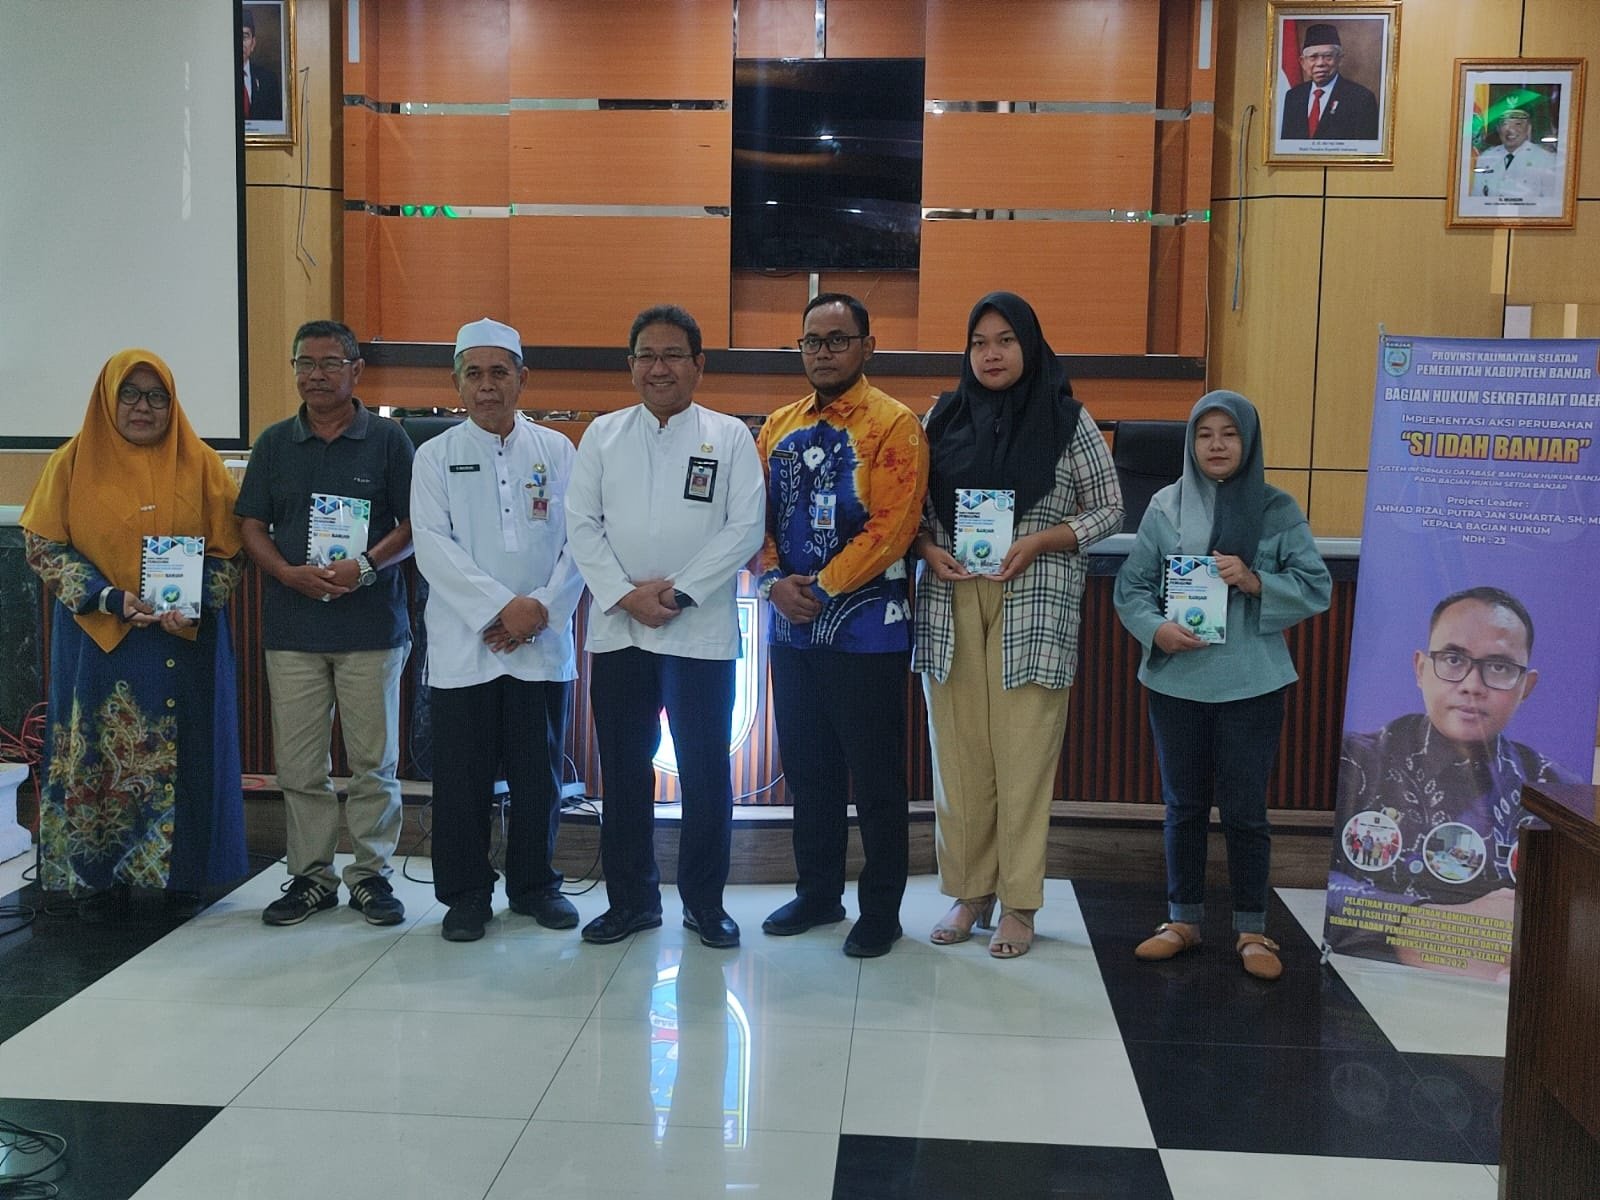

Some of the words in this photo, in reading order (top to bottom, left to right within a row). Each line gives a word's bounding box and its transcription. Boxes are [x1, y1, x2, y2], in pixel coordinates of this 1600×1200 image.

[1432, 351, 1475, 362] PROVINSI
[1477, 352, 1536, 363] KALIMANTAN
[1538, 353, 1578, 363] SELATAN
[1416, 364, 1482, 377] PEMERINTAH
[1484, 366, 1547, 378] KABUPATEN
[1549, 368, 1592, 379] BANJAR
[1385, 388, 1430, 402] BAGIAN
[1432, 389, 1479, 404] HUKUM
[1481, 391, 1567, 406] SEKRETARIAT
[1402, 414, 1485, 426] IMPLEMENTASI
[1488, 418, 1515, 427] AKSI
[1518, 420, 1593, 430] PERUBAHAN
[1435, 433, 1490, 459] IDAH
[1453, 469, 1496, 478] DATABASE
[1498, 471, 1539, 479] BANTUAN
[1541, 473, 1573, 481] HUKUM
[1471, 479, 1502, 487] HUKUM
[1447, 496, 1485, 507] Project
[1487, 498, 1523, 508] Leader
[1375, 505, 1413, 514] AHMAD
[1415, 507, 1445, 516] RIZAL
[1447, 509, 1482, 518] PUTRA
[1484, 511, 1506, 519] JAN
[1508, 513, 1565, 523] SUMARTA,
[1422, 519, 1463, 530] KEPALA
[1466, 522, 1508, 532] BAGIAN
[1510, 525, 1551, 535] HUKUM
[1462, 535, 1486, 544] NDH
[1494, 537, 1506, 545] 23
